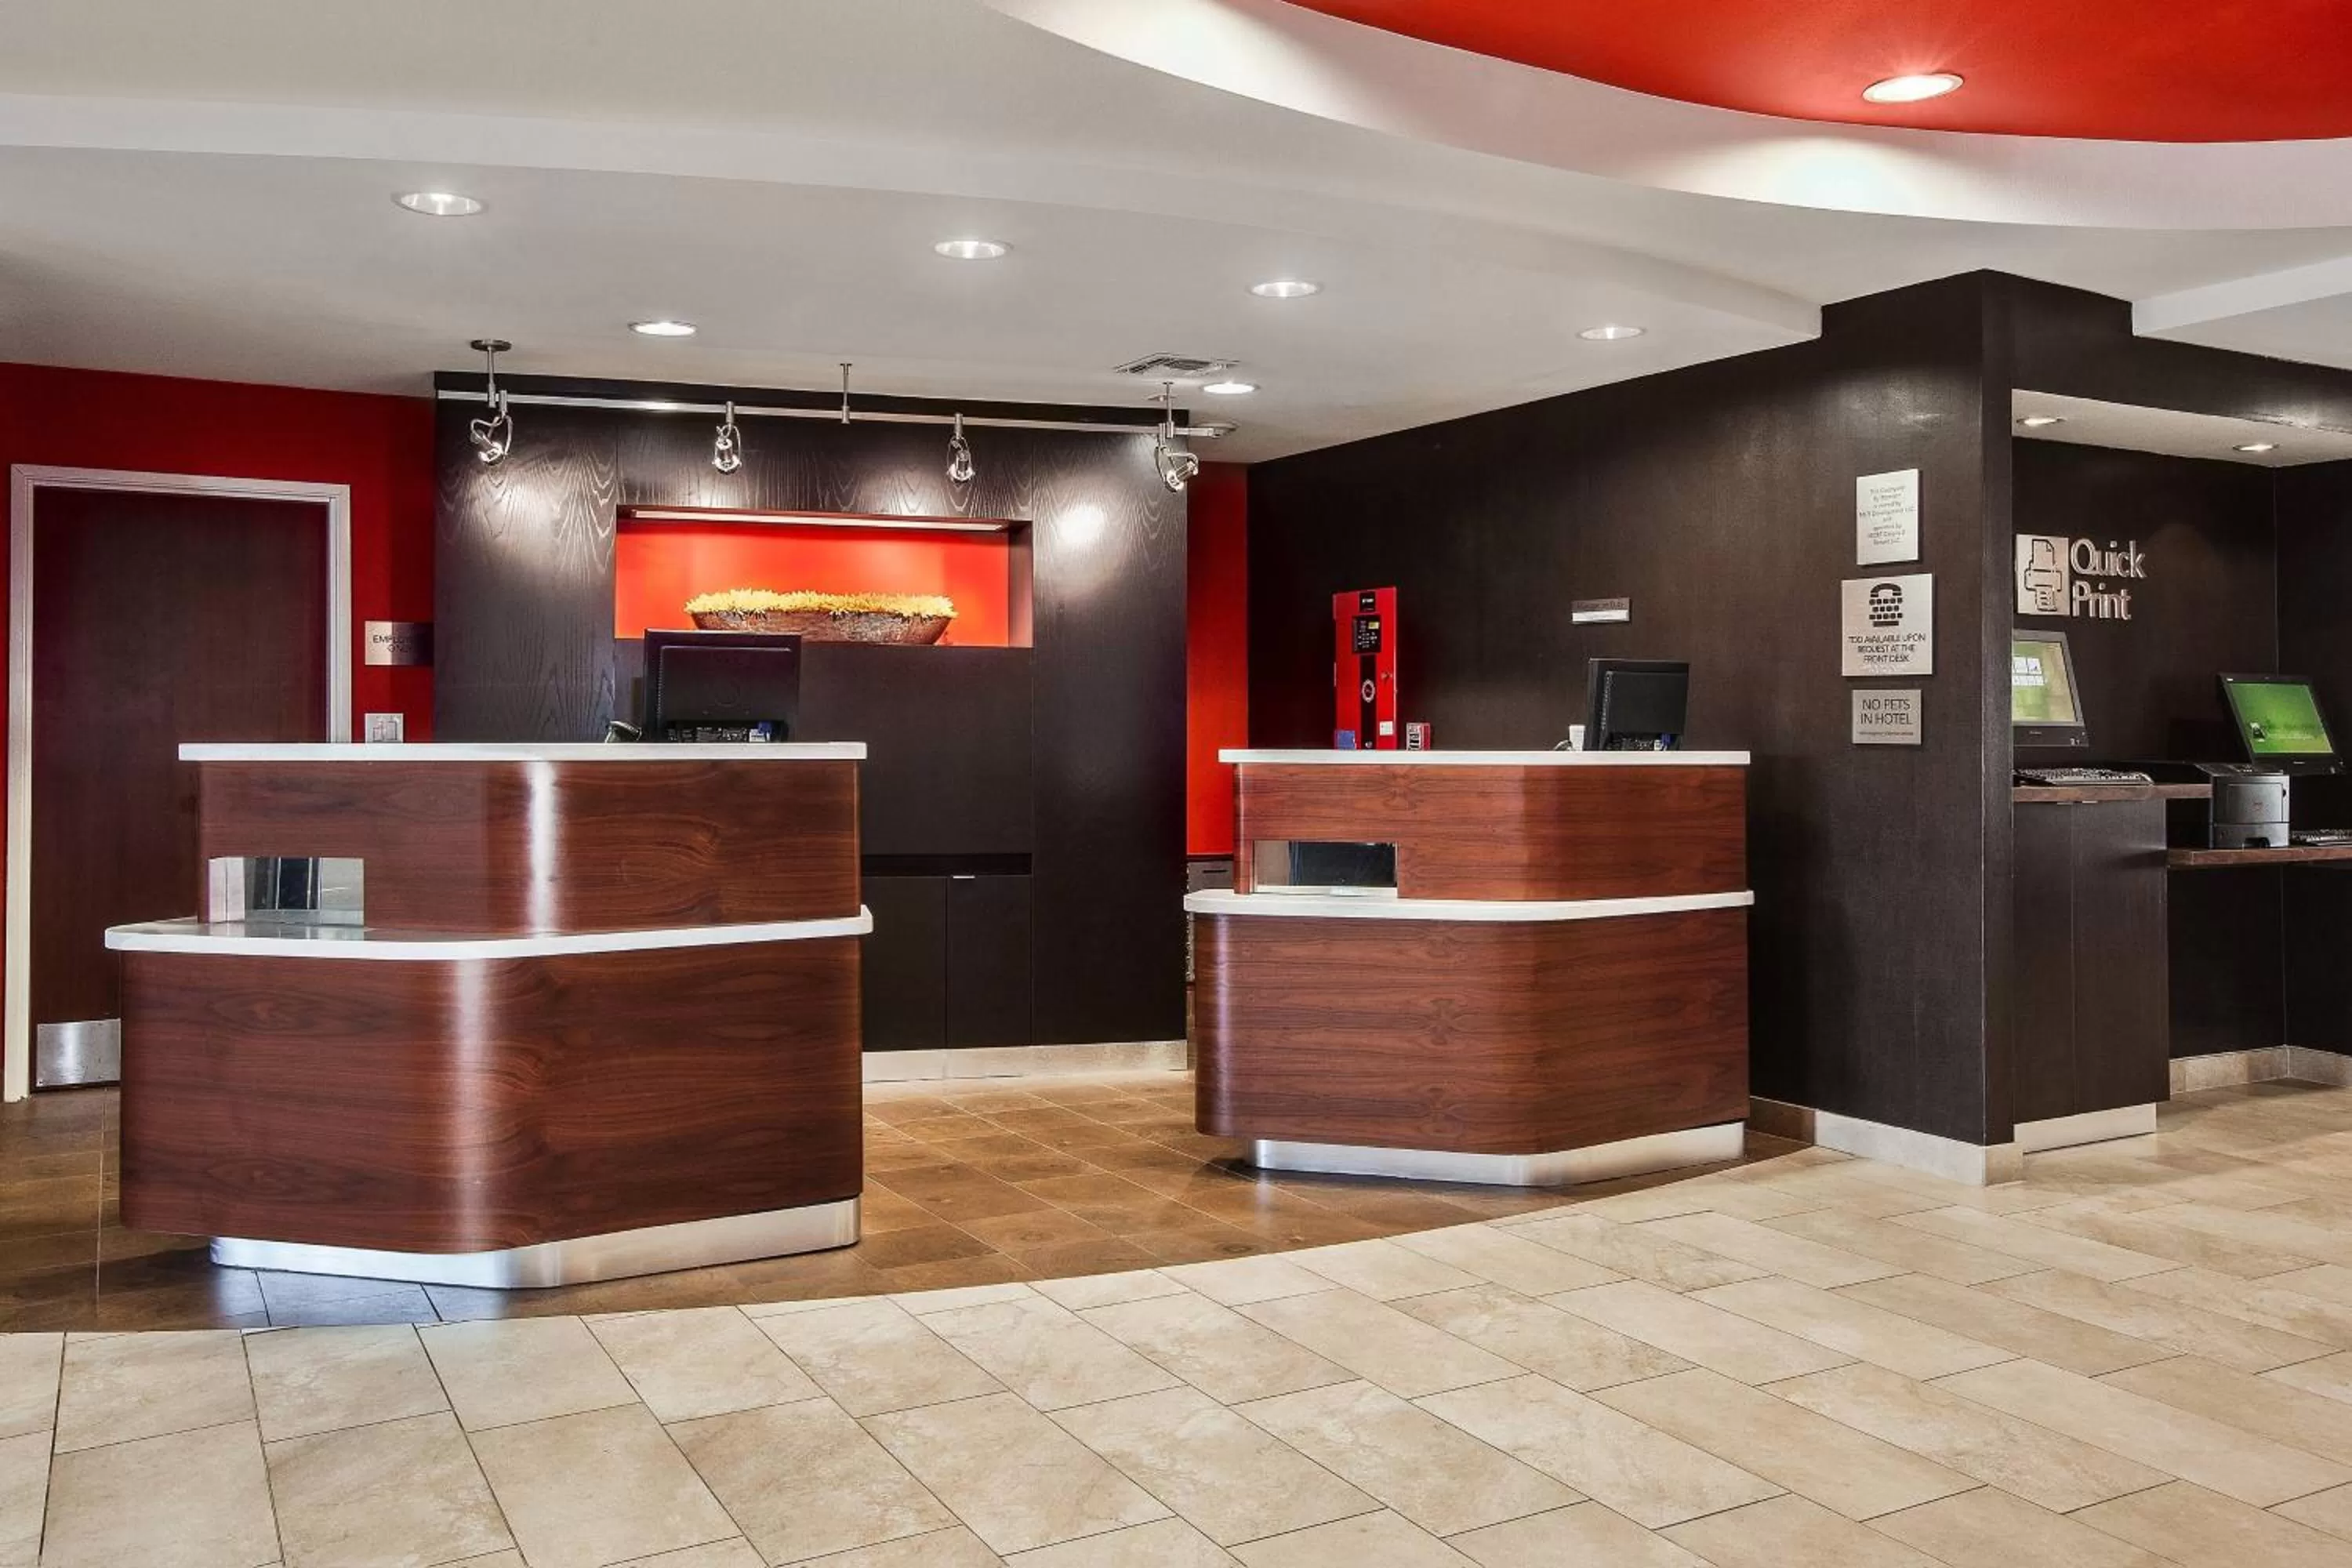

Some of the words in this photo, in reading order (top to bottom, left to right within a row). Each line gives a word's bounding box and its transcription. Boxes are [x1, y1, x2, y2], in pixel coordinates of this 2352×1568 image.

[2071, 538, 2147, 578] Quick
[2072, 580, 2132, 620] Print
[1889, 654, 1910, 662] DESK
[1862, 699, 1880, 710] NO
[1884, 699, 1911, 710] PETS
[1860, 713, 1872, 725] IN
[1875, 713, 1913, 725] HOTEL
